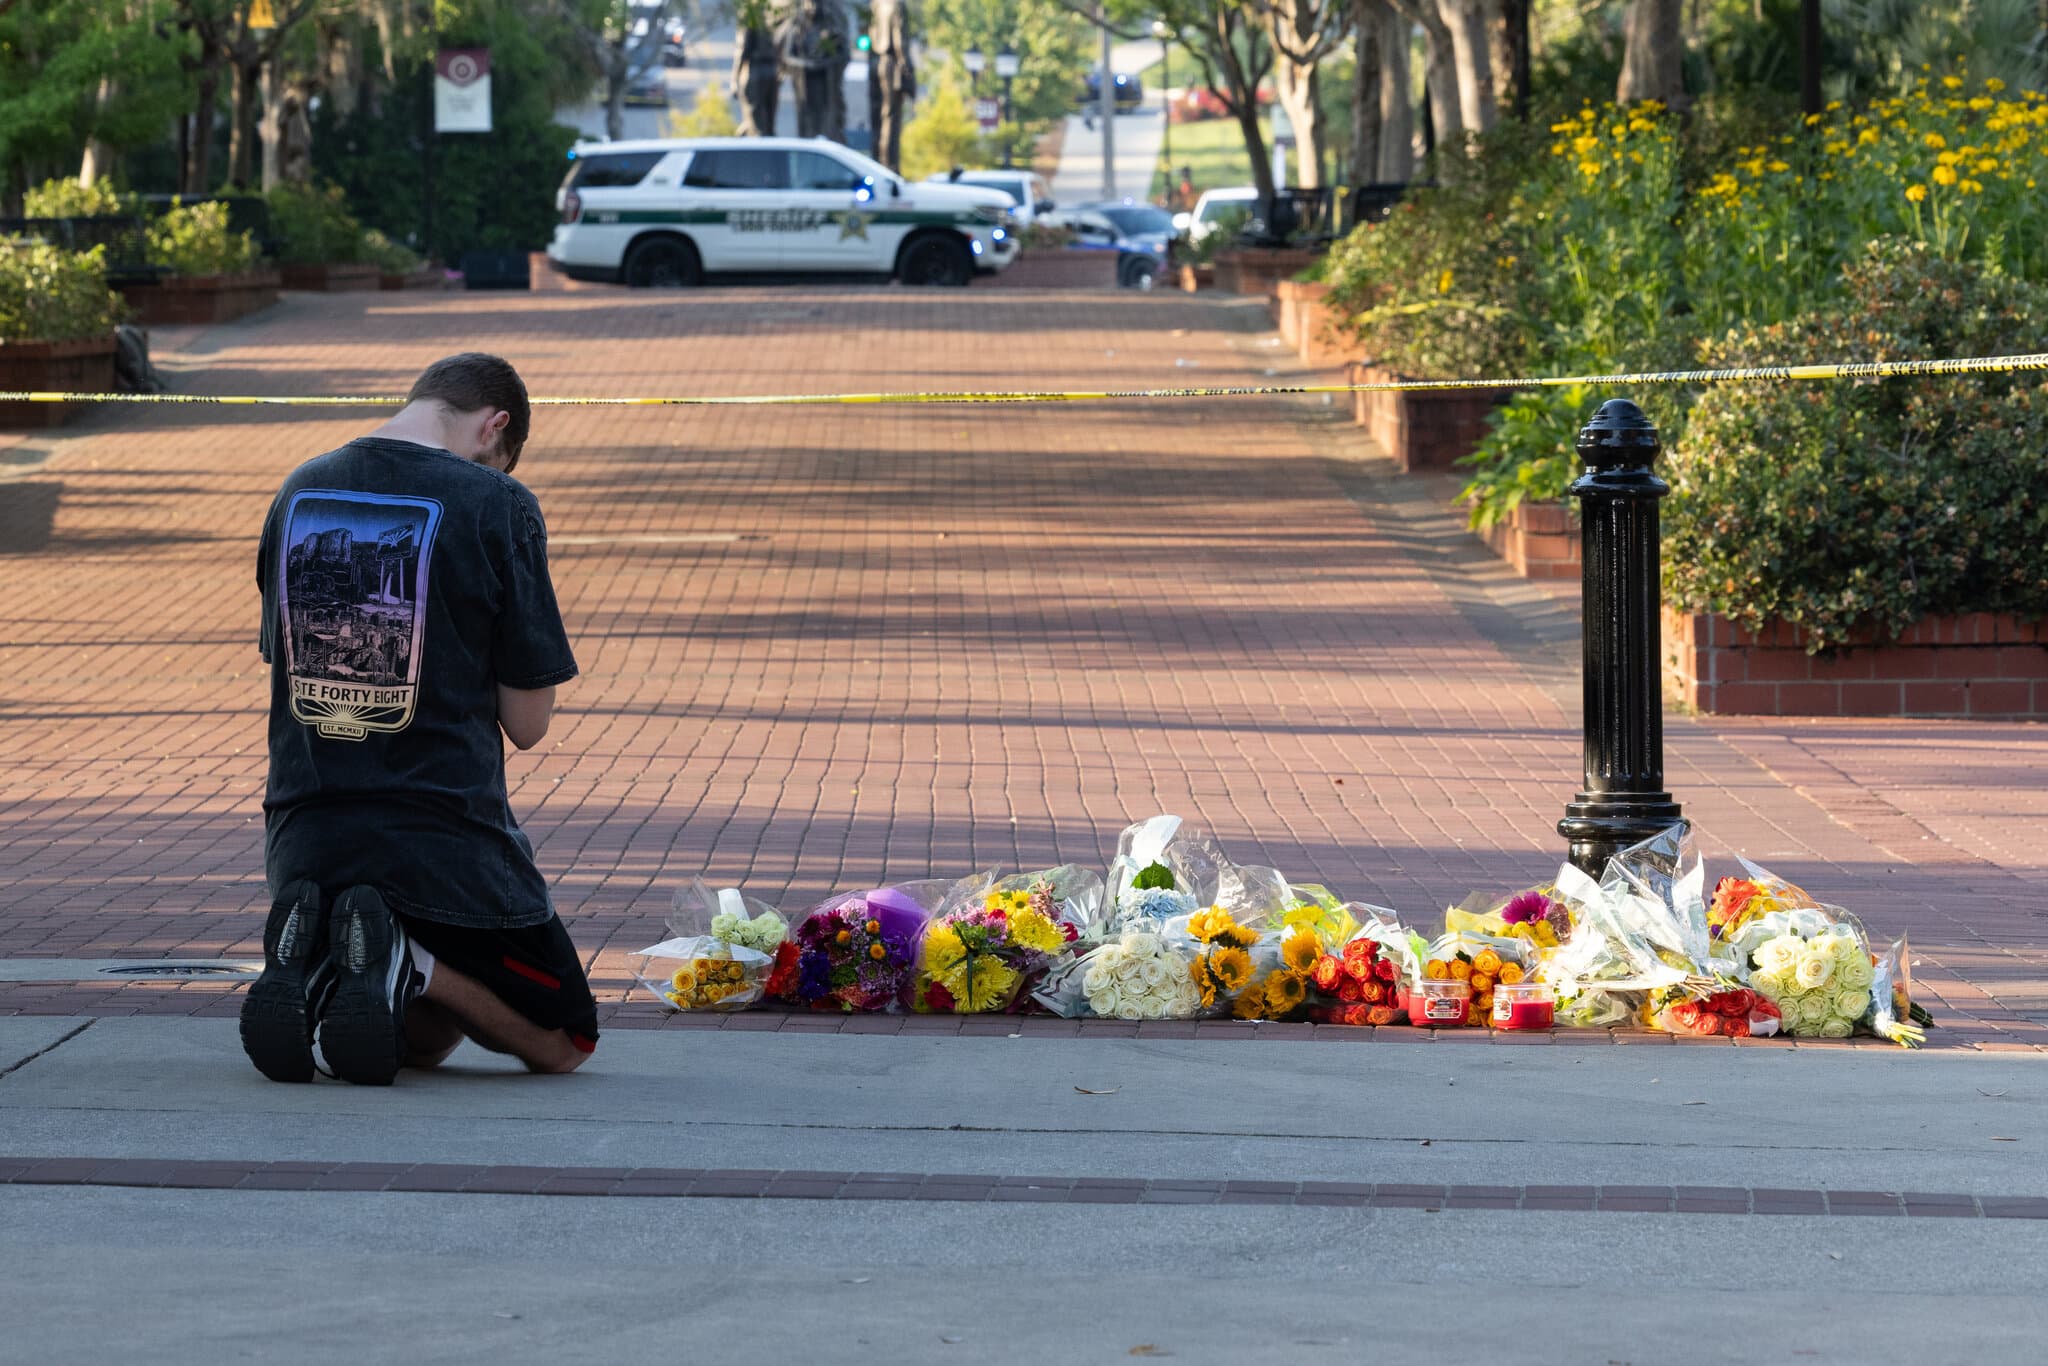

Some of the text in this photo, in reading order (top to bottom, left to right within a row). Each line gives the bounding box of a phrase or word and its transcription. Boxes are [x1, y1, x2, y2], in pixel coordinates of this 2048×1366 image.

[294, 679, 410, 704] STE FORTY EIGHT
[323, 724, 336, 732] EST.
